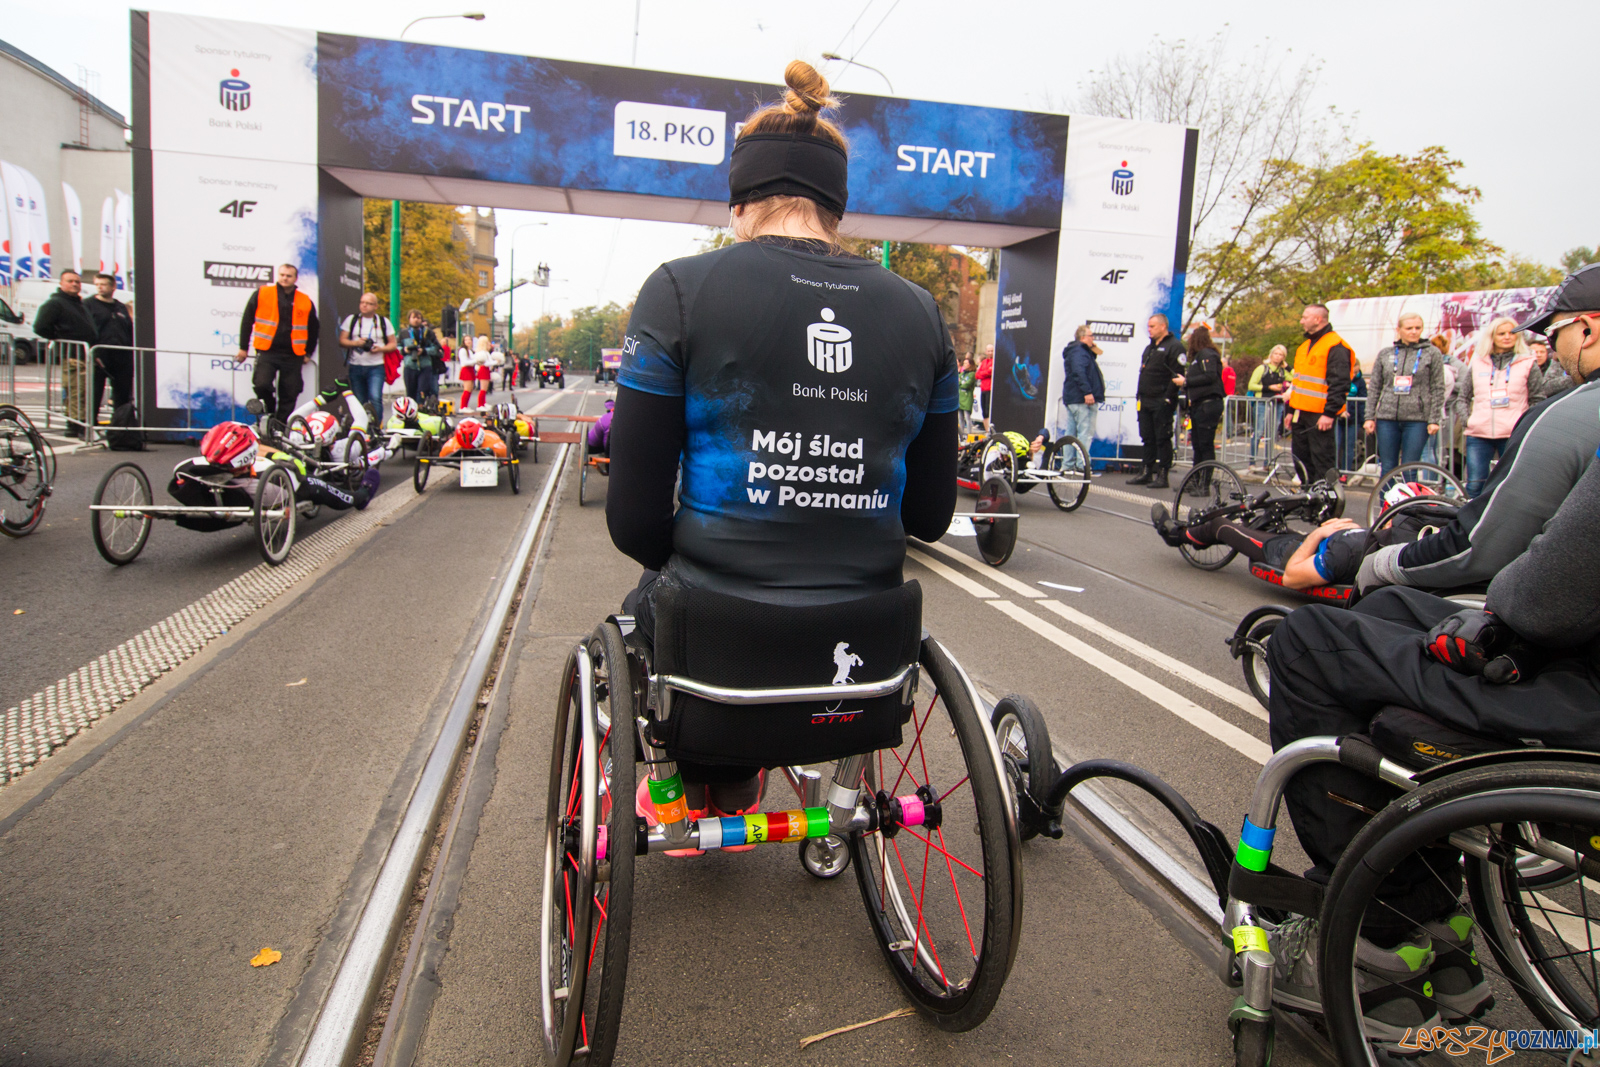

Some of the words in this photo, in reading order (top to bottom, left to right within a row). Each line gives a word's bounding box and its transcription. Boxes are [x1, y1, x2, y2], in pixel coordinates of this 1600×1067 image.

[209, 118, 232, 128] Bank
[236, 120, 263, 131] Polski
[411, 94, 531, 134] START
[896, 144, 995, 178] START
[219, 199, 258, 218] 4F
[791, 274, 823, 288] Sponsor
[824, 281, 859, 292] Tytularny
[1101, 269, 1129, 284] 4F
[792, 383, 826, 400] Bank
[830, 386, 868, 402] Polski
[752, 429, 802, 461] Mój
[809, 433, 864, 459] ślad
[747, 460, 865, 485] pozostał
[746, 488, 771, 505] w
[778, 486, 889, 510] Poznaniu
